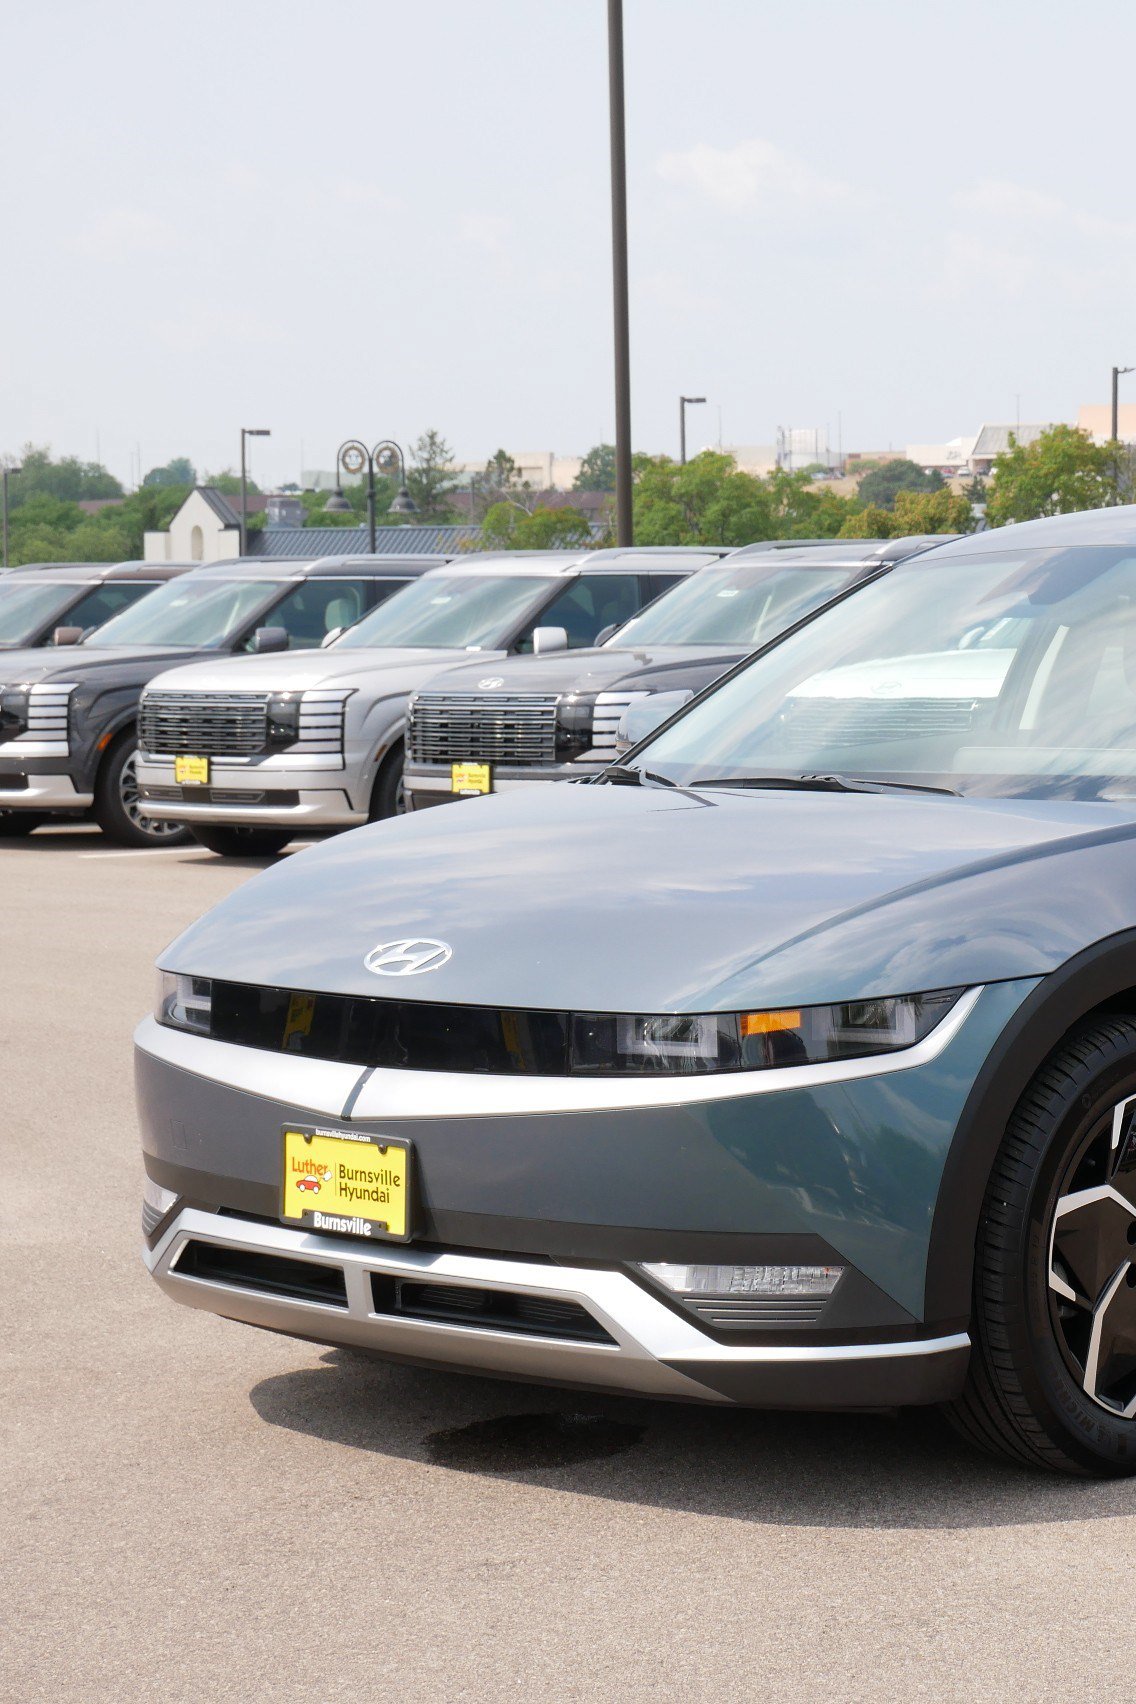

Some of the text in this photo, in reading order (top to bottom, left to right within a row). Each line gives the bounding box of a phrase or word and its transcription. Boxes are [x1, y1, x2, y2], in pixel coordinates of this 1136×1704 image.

[292, 1157, 329, 1176] Luther
[339, 1164, 401, 1187] Burnsville
[339, 1182, 390, 1204] Hyundai
[313, 1211, 372, 1236] Burnsville
